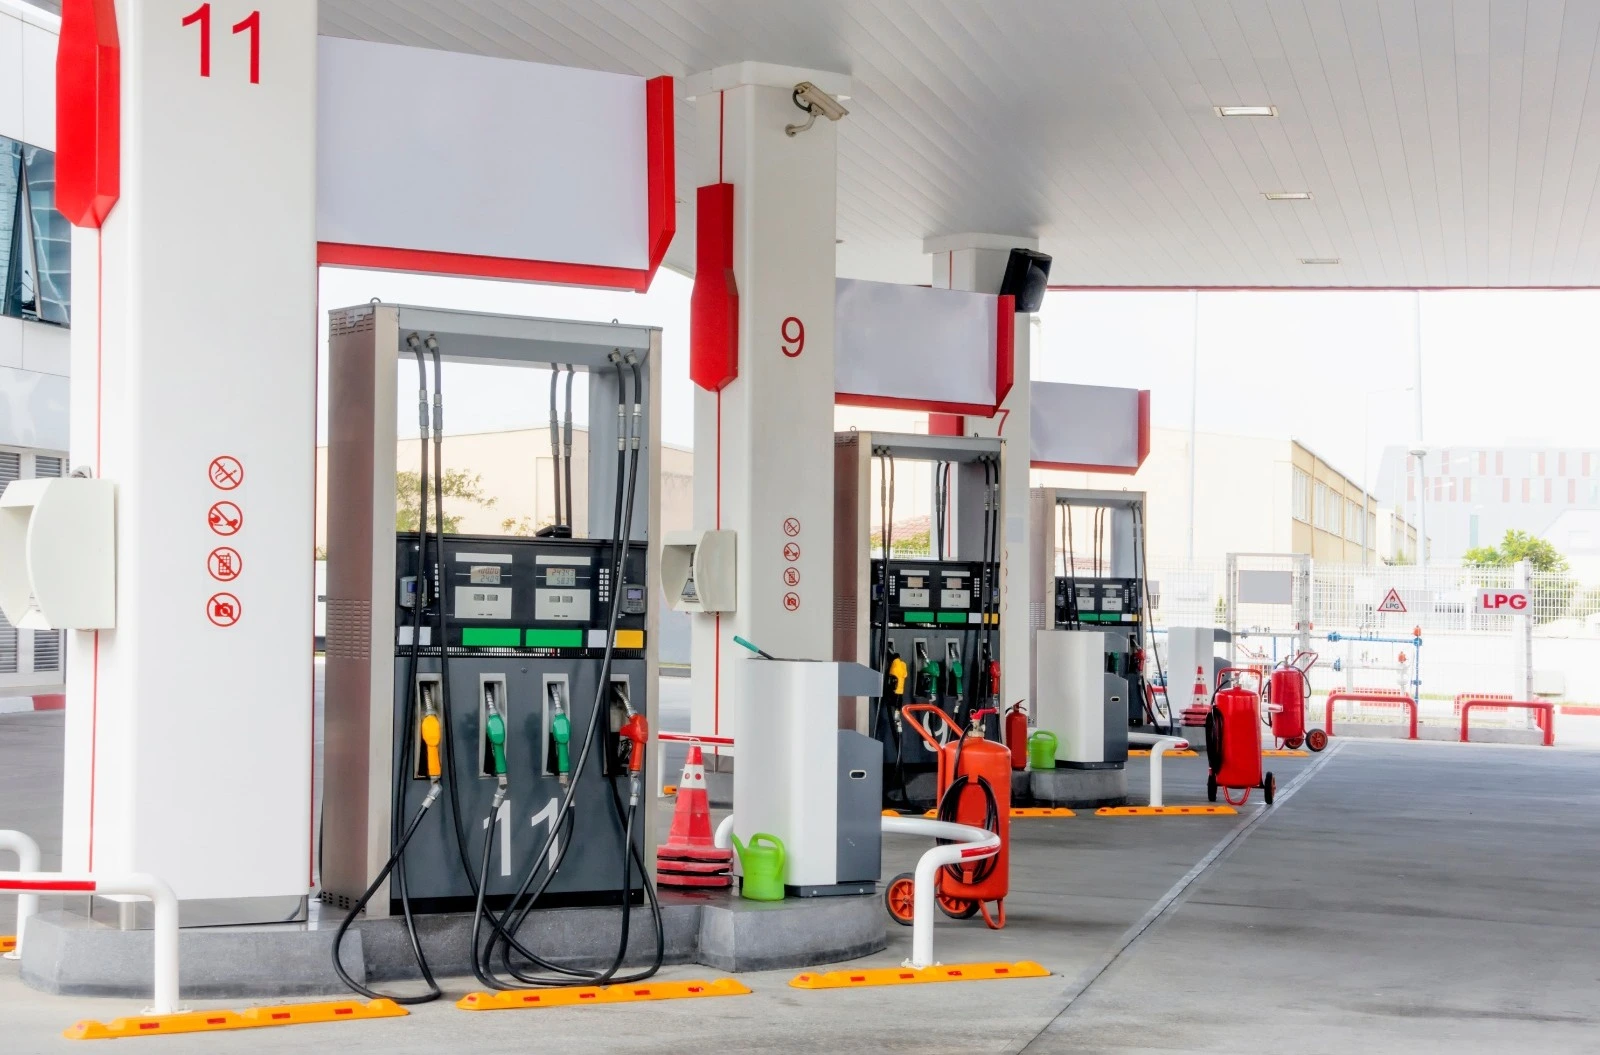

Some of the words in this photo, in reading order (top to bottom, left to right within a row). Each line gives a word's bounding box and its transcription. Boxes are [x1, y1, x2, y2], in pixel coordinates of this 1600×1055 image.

[181, 2, 261, 85] 11
[781, 316, 805, 358] 9
[996, 408, 1010, 437] 7
[1483, 594, 1527, 610] LPG
[922, 710, 949, 752] 9
[483, 797, 559, 877] 11
